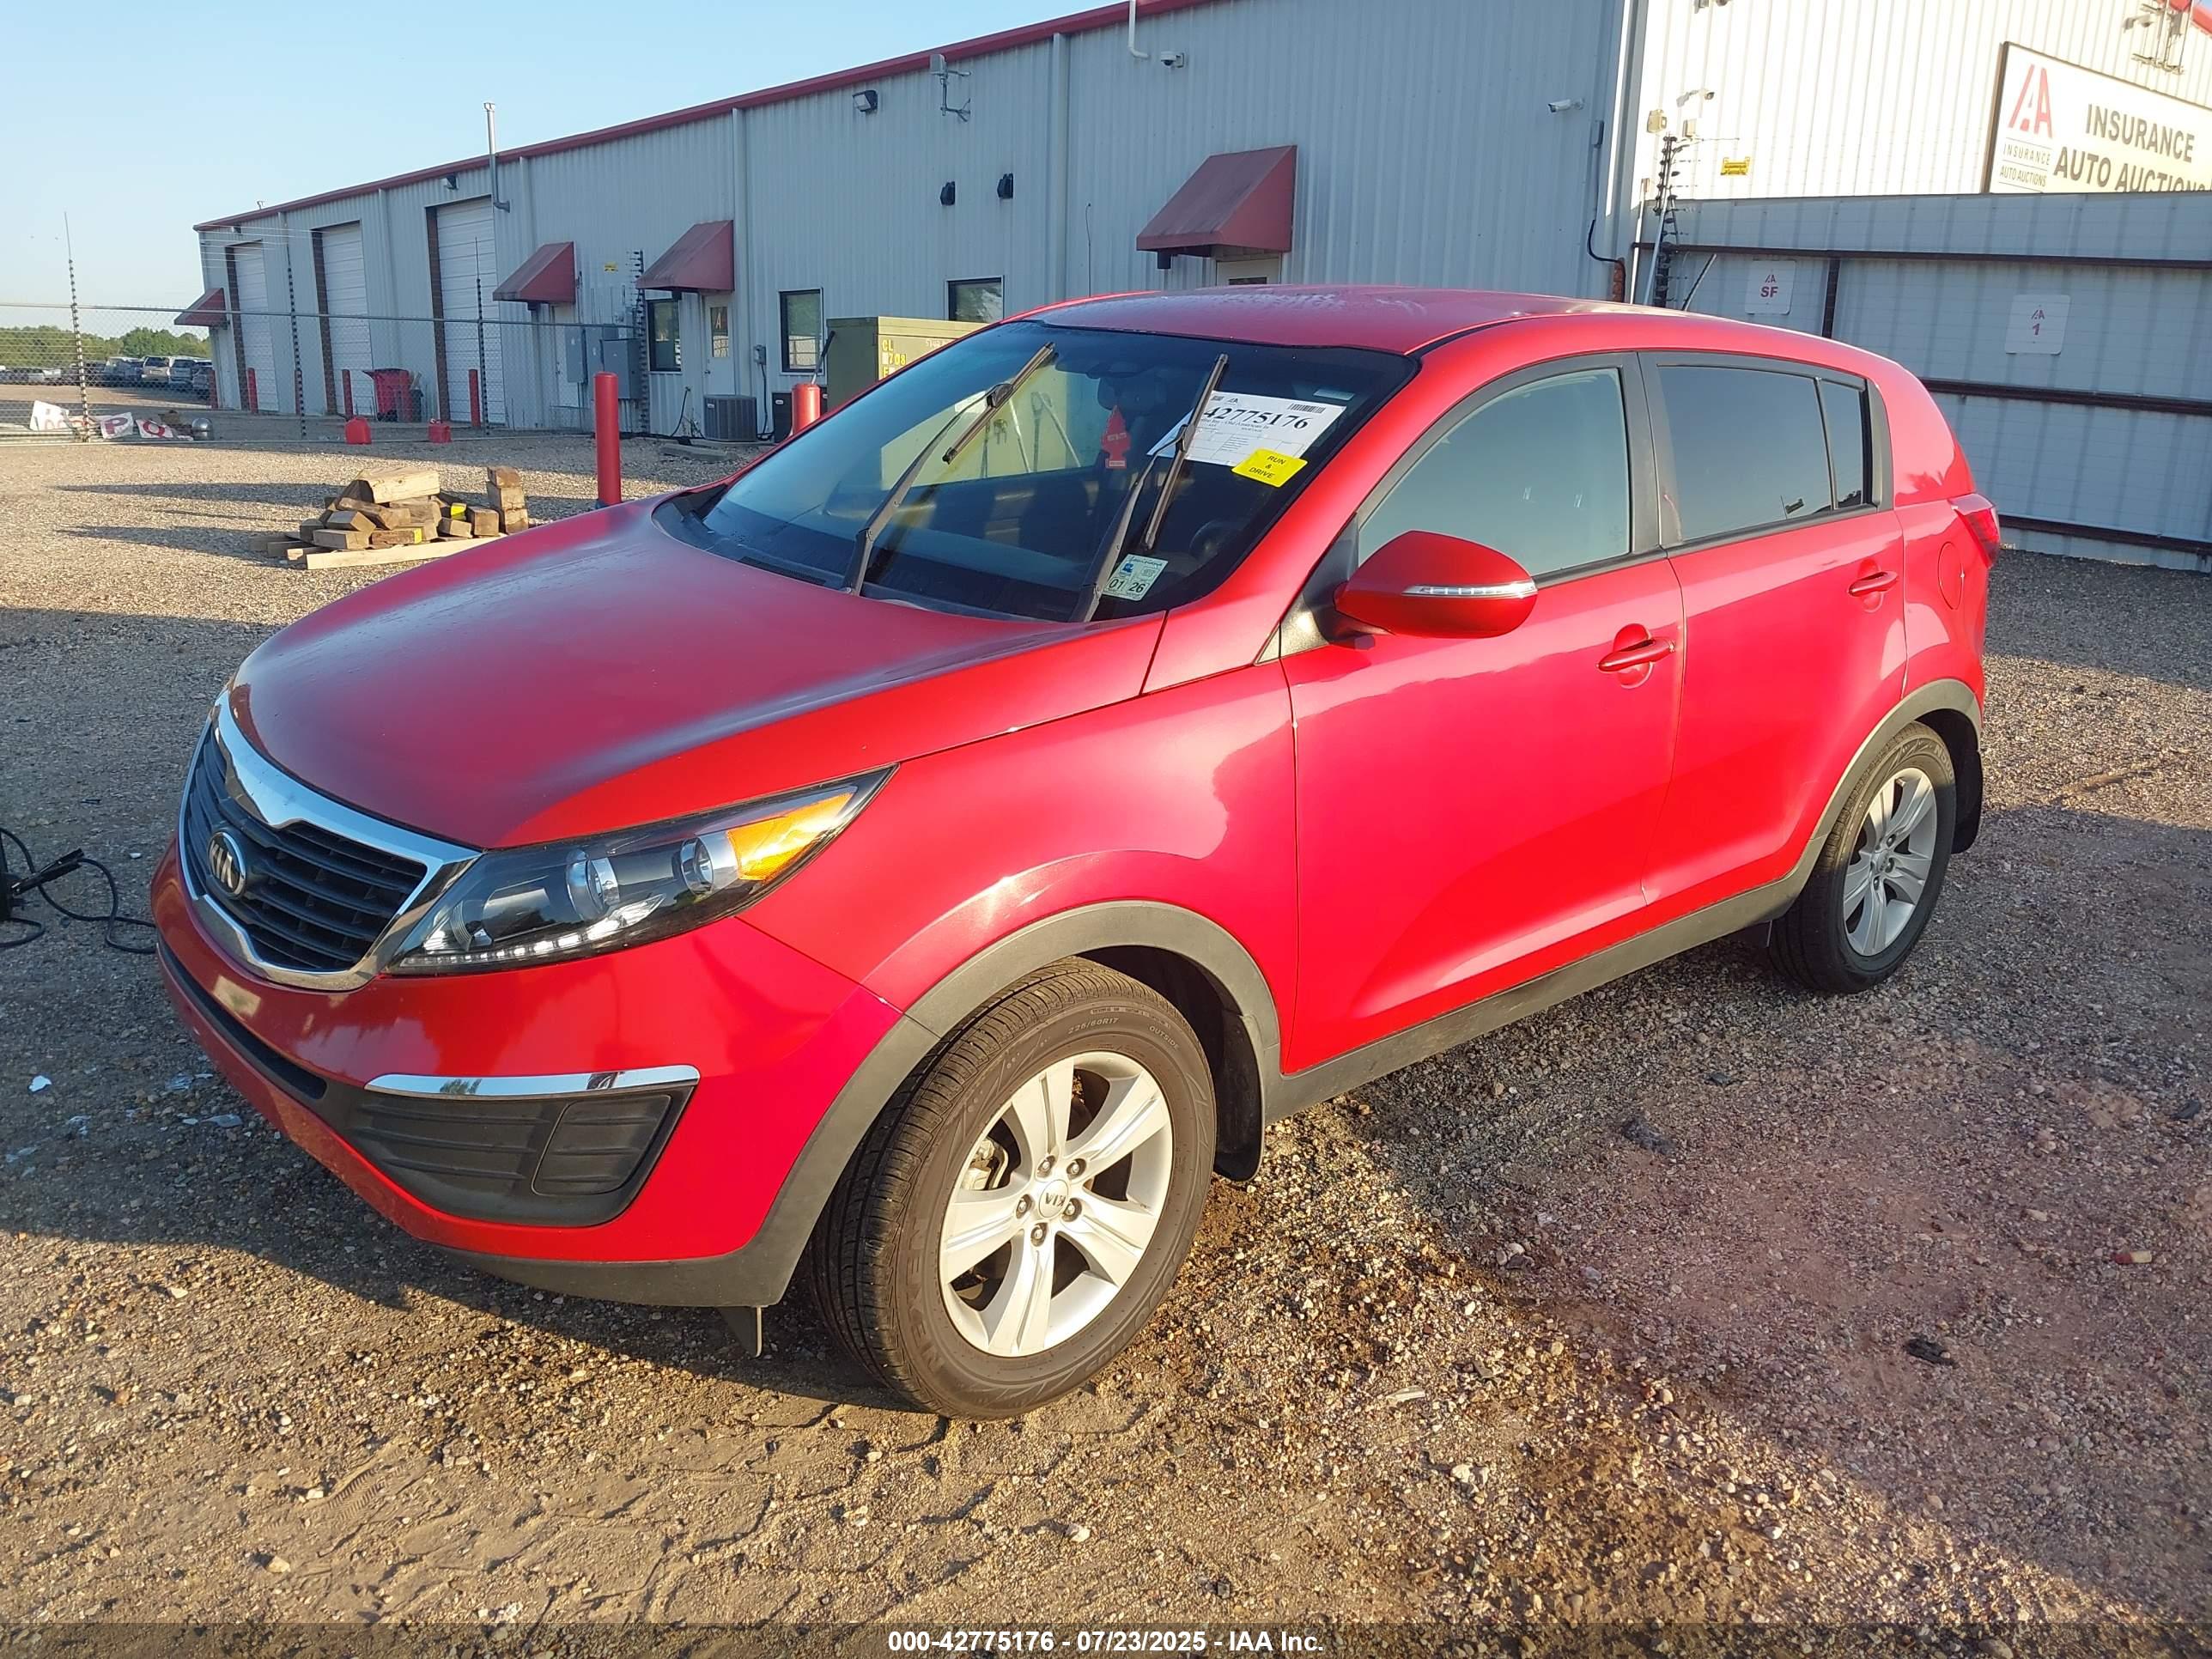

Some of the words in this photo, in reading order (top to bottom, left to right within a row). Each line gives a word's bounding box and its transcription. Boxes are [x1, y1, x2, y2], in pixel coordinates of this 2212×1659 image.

[2086, 104, 2195, 163] INSURANCE
[2003, 143, 2051, 166] INSURANCE
[2054, 147, 2112, 187] AUTO
[2115, 163, 2205, 191] AUCTIO
[1999, 166, 2016, 180] AUTO
[2018, 169, 2047, 187] AUCTIONS
[1760, 286, 1778, 298] SF
[2033, 323, 2040, 335] 1
[882, 339, 893, 351] CL
[1204, 407, 1312, 429] 42775176
[1267, 455, 1286, 465] RUN
[1249, 467, 1275, 478] DRIVE
[1109, 579, 1125, 590] 01
[1129, 582, 1146, 593] 26
